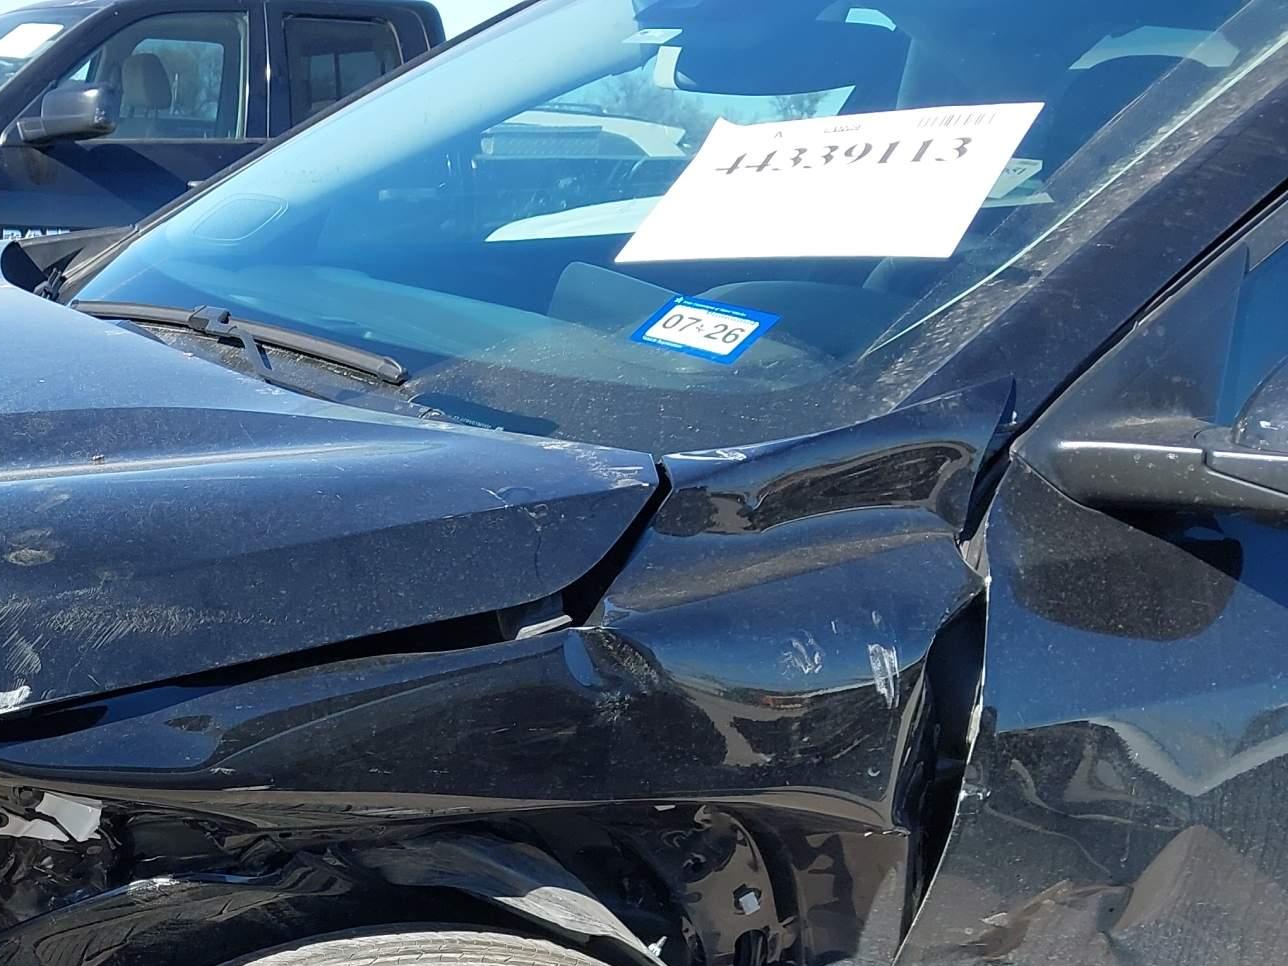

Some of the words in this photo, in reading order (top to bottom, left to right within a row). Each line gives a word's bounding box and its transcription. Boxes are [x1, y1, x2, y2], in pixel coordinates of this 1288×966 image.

[715, 136, 973, 175] 44339113
[662, 313, 702, 332] 07
[704, 323, 746, 344] 26
